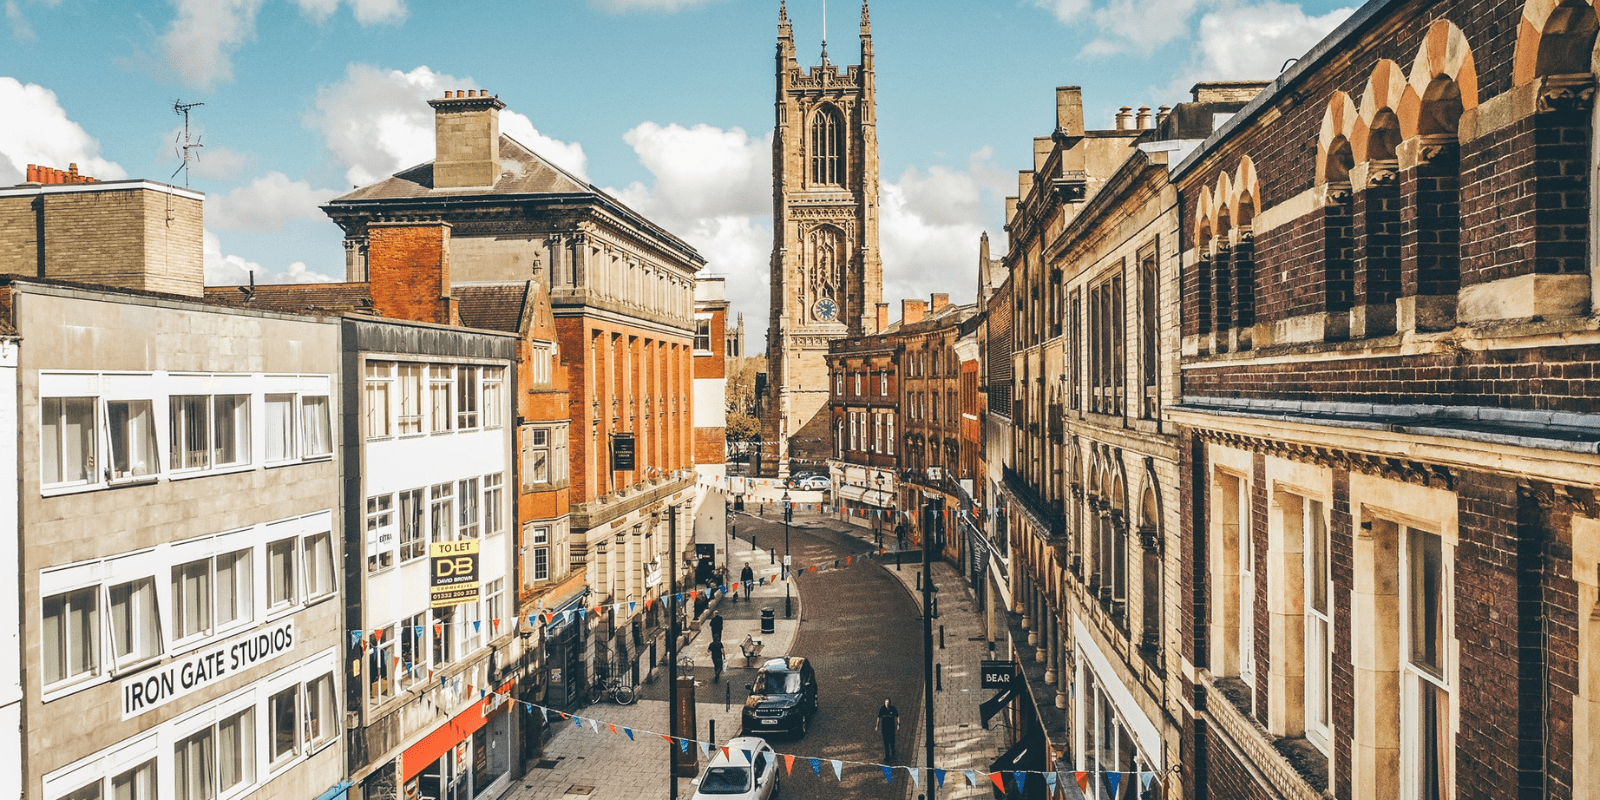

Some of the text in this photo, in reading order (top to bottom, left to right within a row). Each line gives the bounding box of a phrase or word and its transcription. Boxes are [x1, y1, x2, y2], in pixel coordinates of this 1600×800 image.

[439, 542, 470, 553] TO LET
[125, 624, 292, 714] IRON GATE STUDIOS
[986, 673, 1010, 682] BEAR
